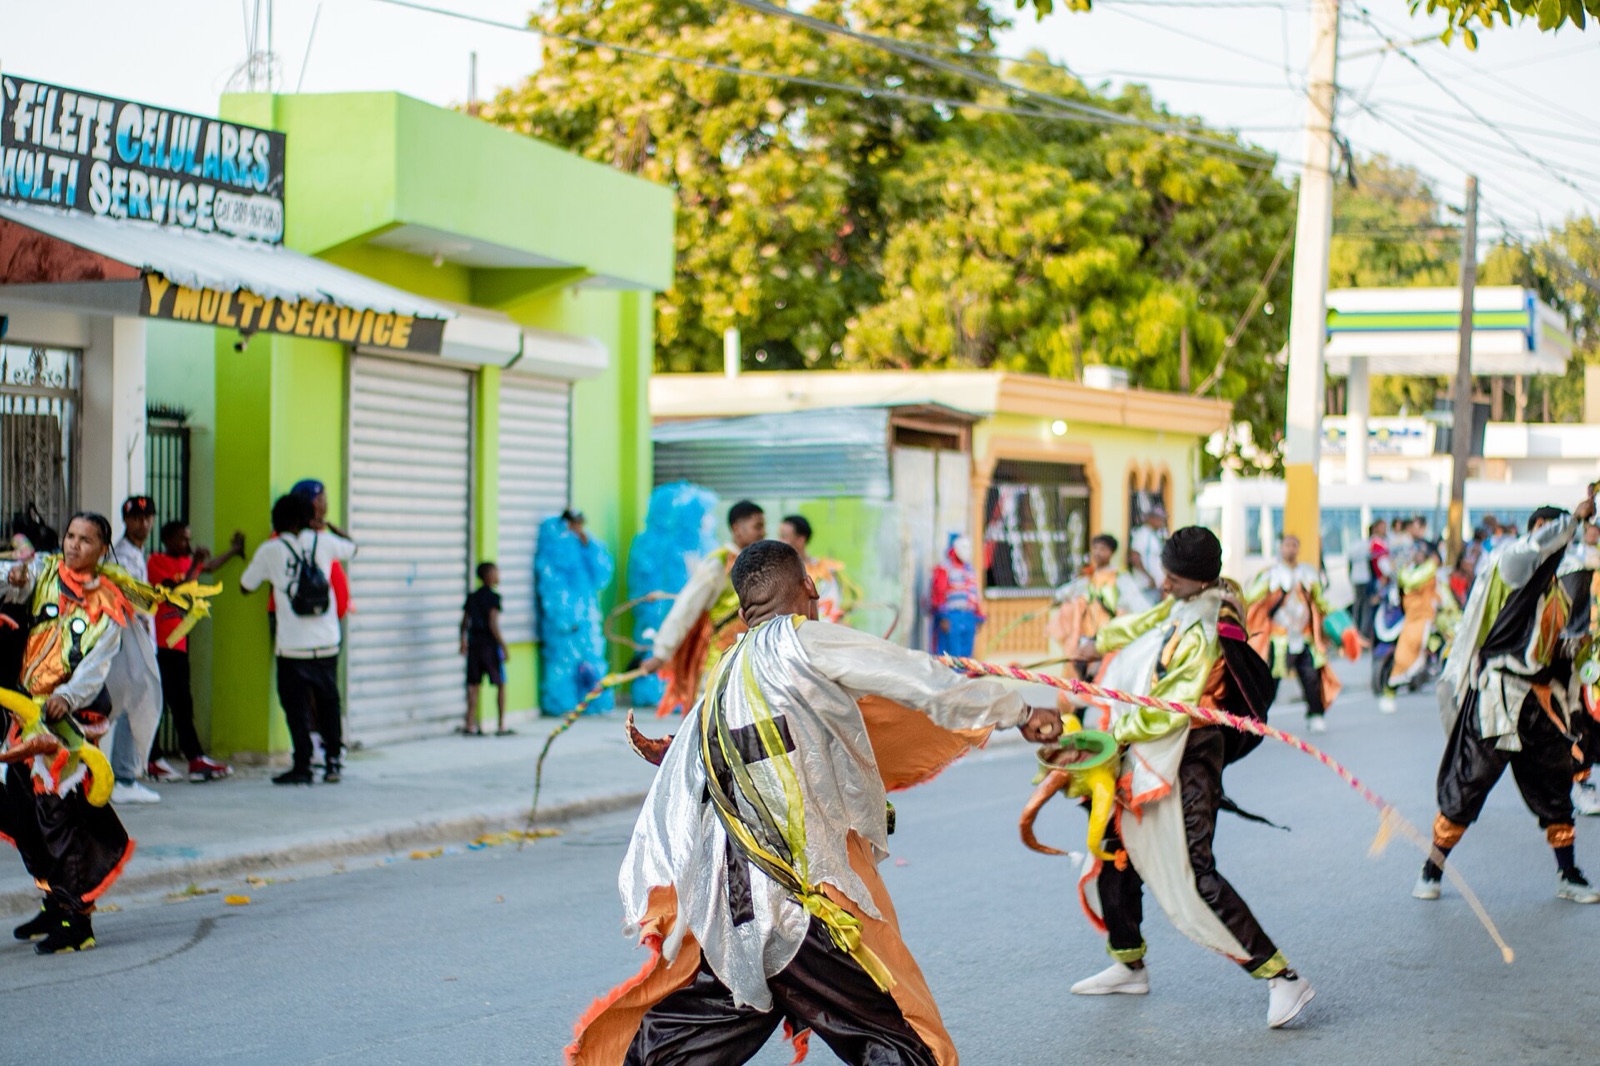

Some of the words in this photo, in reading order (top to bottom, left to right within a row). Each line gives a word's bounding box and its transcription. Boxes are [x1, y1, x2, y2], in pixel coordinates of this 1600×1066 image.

[0, 146, 80, 206] MULTI
[88, 160, 215, 232] SERVICE
[115, 102, 271, 192] CELULARES
[146, 273, 171, 315] Y
